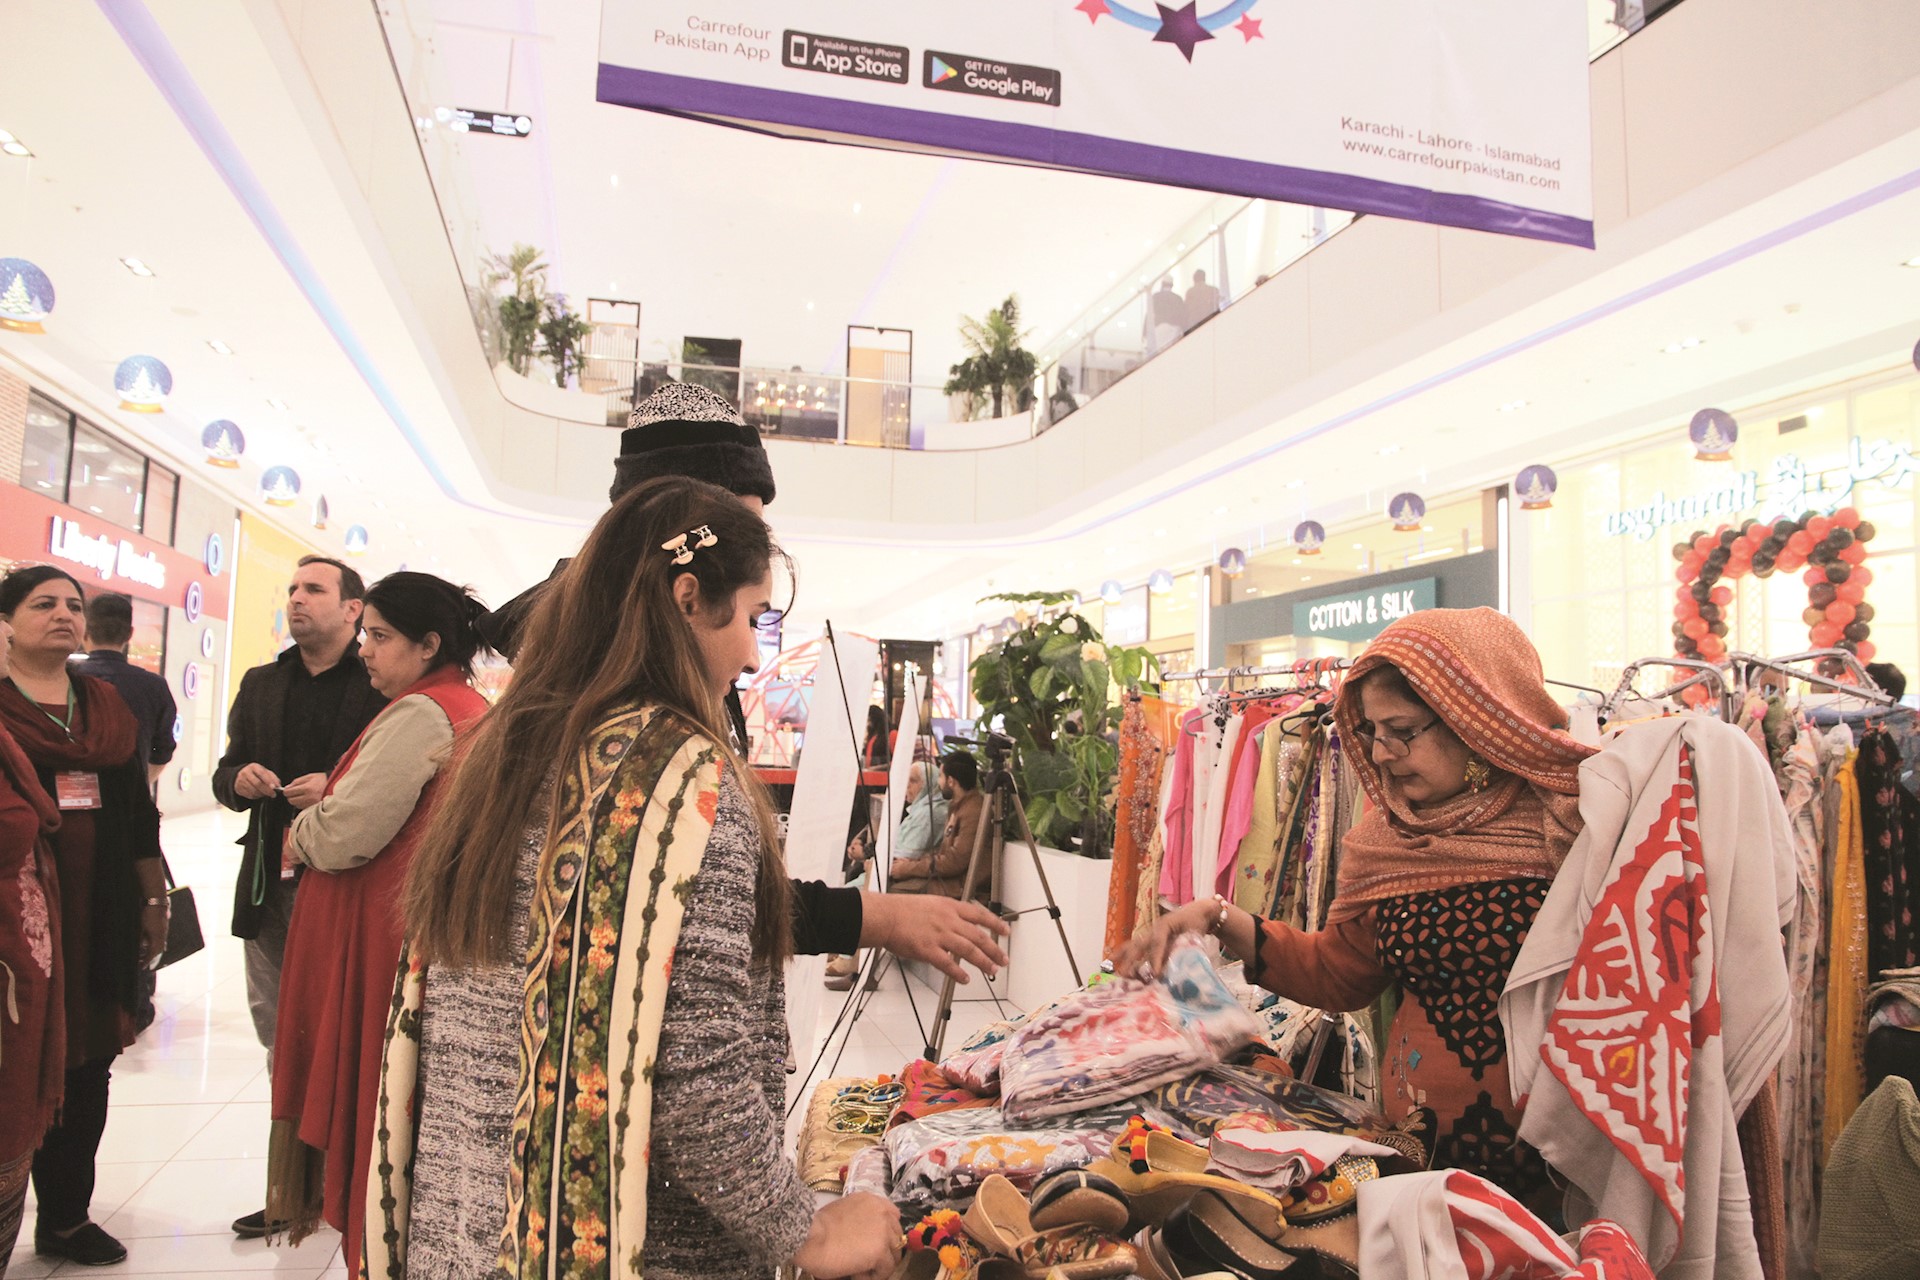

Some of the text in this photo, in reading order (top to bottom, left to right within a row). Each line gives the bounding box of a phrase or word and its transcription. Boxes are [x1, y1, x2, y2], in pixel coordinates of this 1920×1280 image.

[687, 15, 771, 40] Carrefour
[654, 29, 771, 62] Pakistan App
[814, 38, 902, 59] Available on the iPhone
[813, 48, 902, 78] App Store
[965, 60, 1008, 75] GET IT ON
[964, 71, 1053, 101] Google Play
[1341, 116, 1404, 139] Karachi
[1418, 130, 1473, 151] Lahore
[1485, 144, 1561, 171] Islamabad
[1343, 139, 1561, 190] www.carrefourpakistan.com
[1309, 590, 1415, 631] COTTON & SILK
